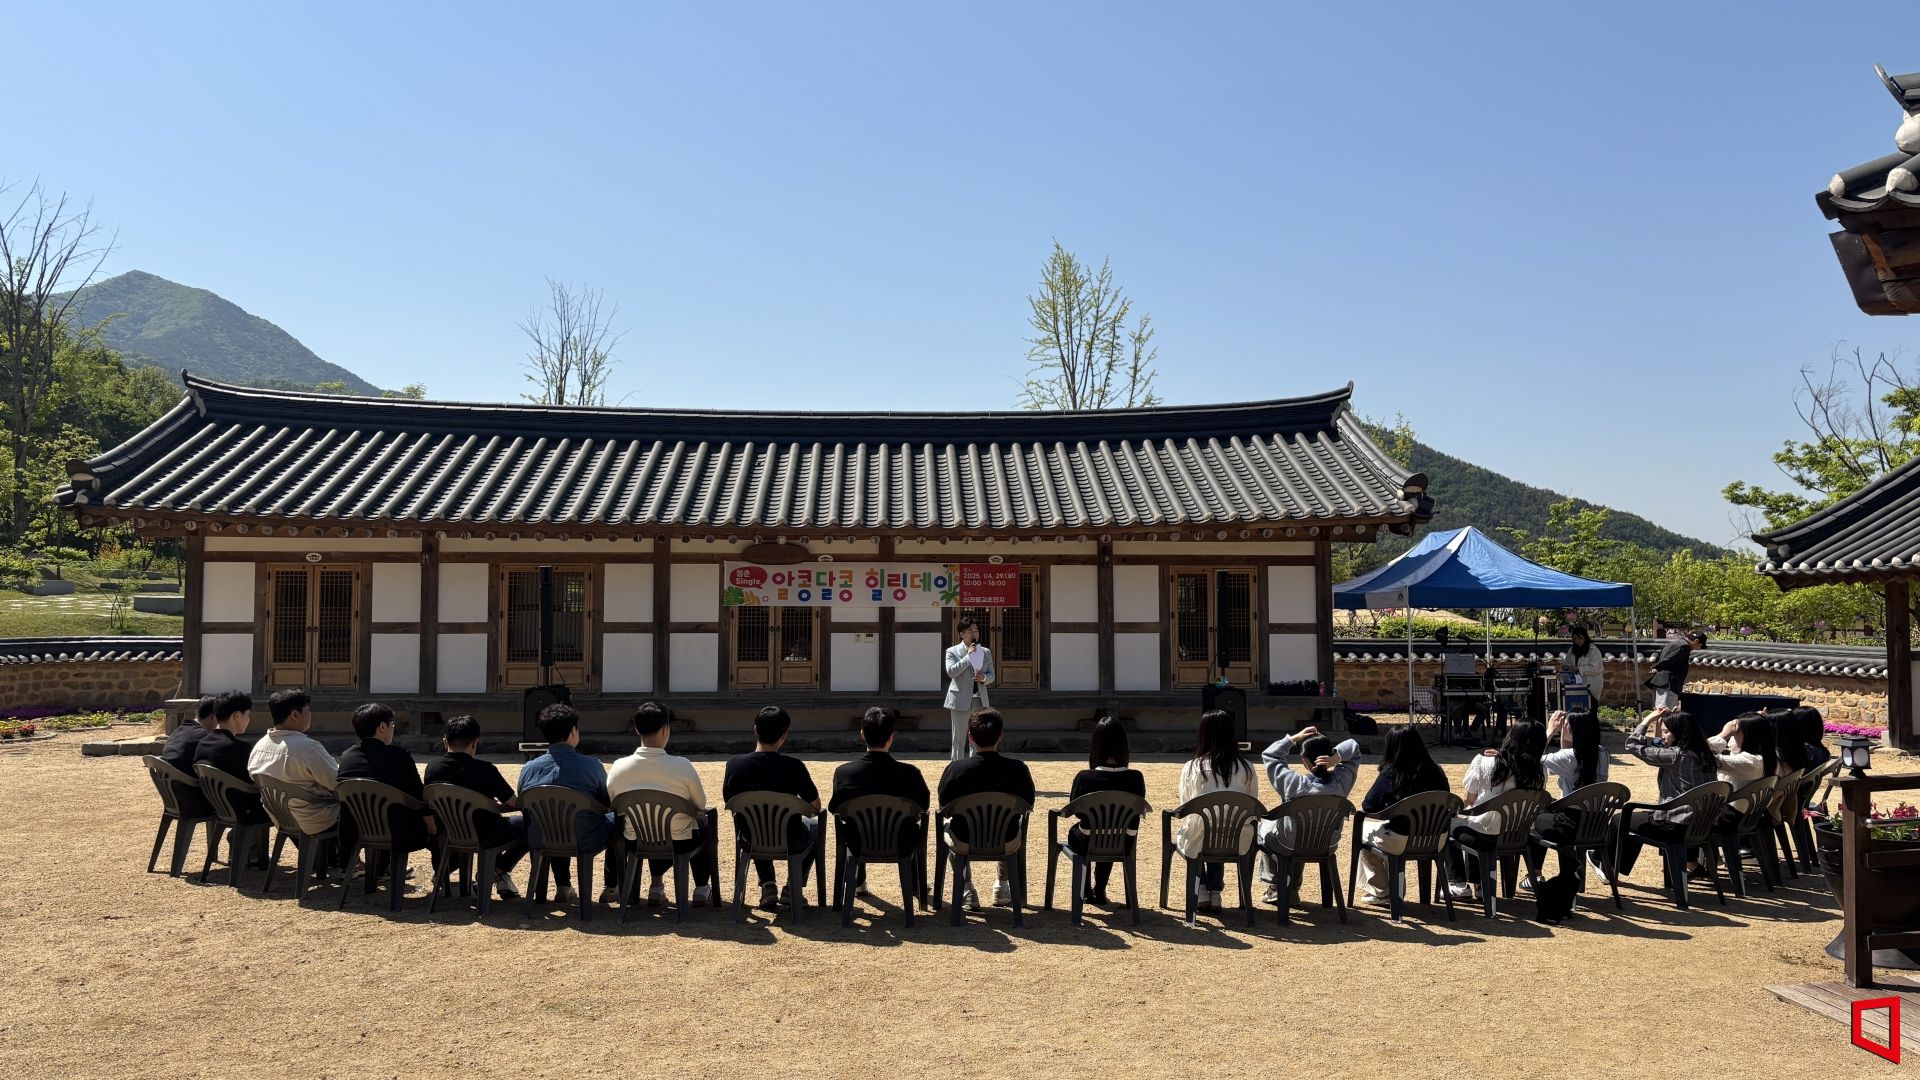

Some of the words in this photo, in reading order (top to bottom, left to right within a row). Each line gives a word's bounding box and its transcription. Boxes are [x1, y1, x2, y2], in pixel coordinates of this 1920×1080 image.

[735, 578, 763, 586] Single.
[772, 570, 853, 602] 알콩달콩
[865, 568, 953, 602] 힐링데이
